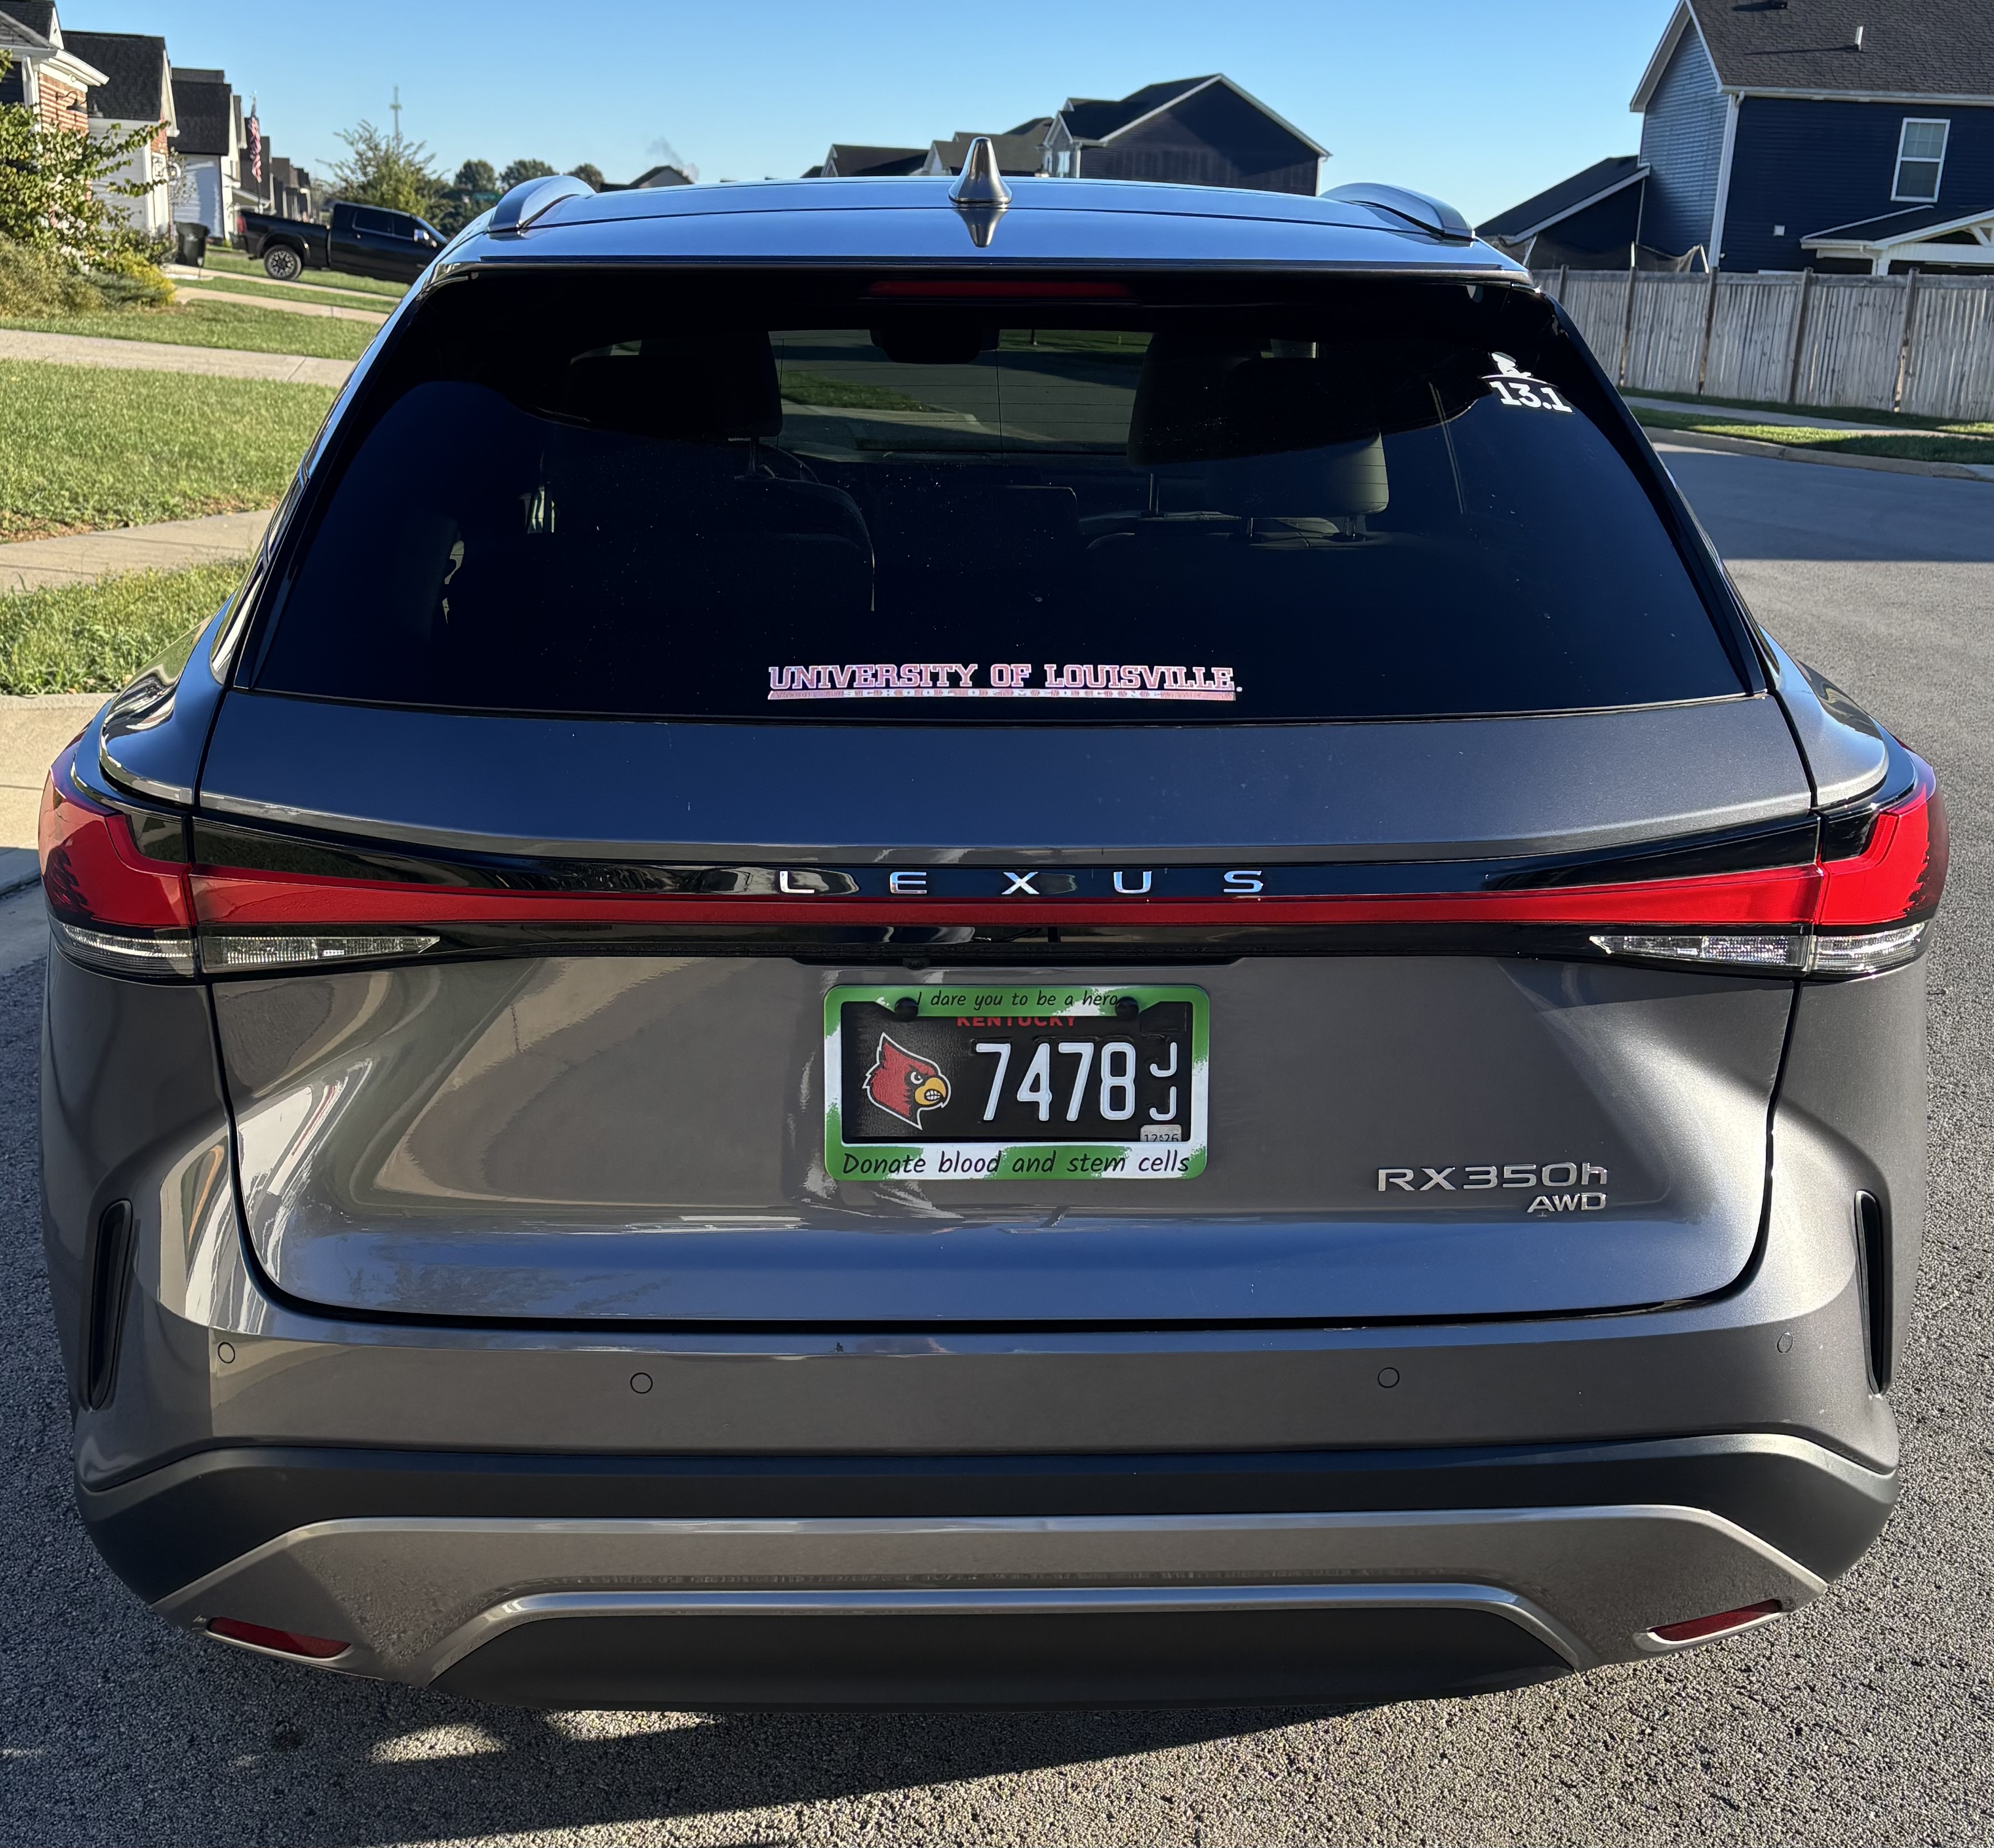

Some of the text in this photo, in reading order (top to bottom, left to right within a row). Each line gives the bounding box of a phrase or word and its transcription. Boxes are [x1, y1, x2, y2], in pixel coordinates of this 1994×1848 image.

[1489, 381, 1573, 412] 13.1
[769, 663, 978, 689] UNIVERSITY
[990, 664, 1031, 687] OF
[779, 871, 1263, 895] LEXUS
[931, 990, 966, 1005] dare
[974, 994, 1003, 1010] you
[1012, 993, 1028, 1005] to
[1037, 990, 1056, 1005] be
[1064, 994, 1073, 1005] a
[976, 1042, 1135, 1121] 7478
[842, 1149, 1189, 1173] Donate blood and stem cells
[1527, 1192, 1607, 1213] AWD
